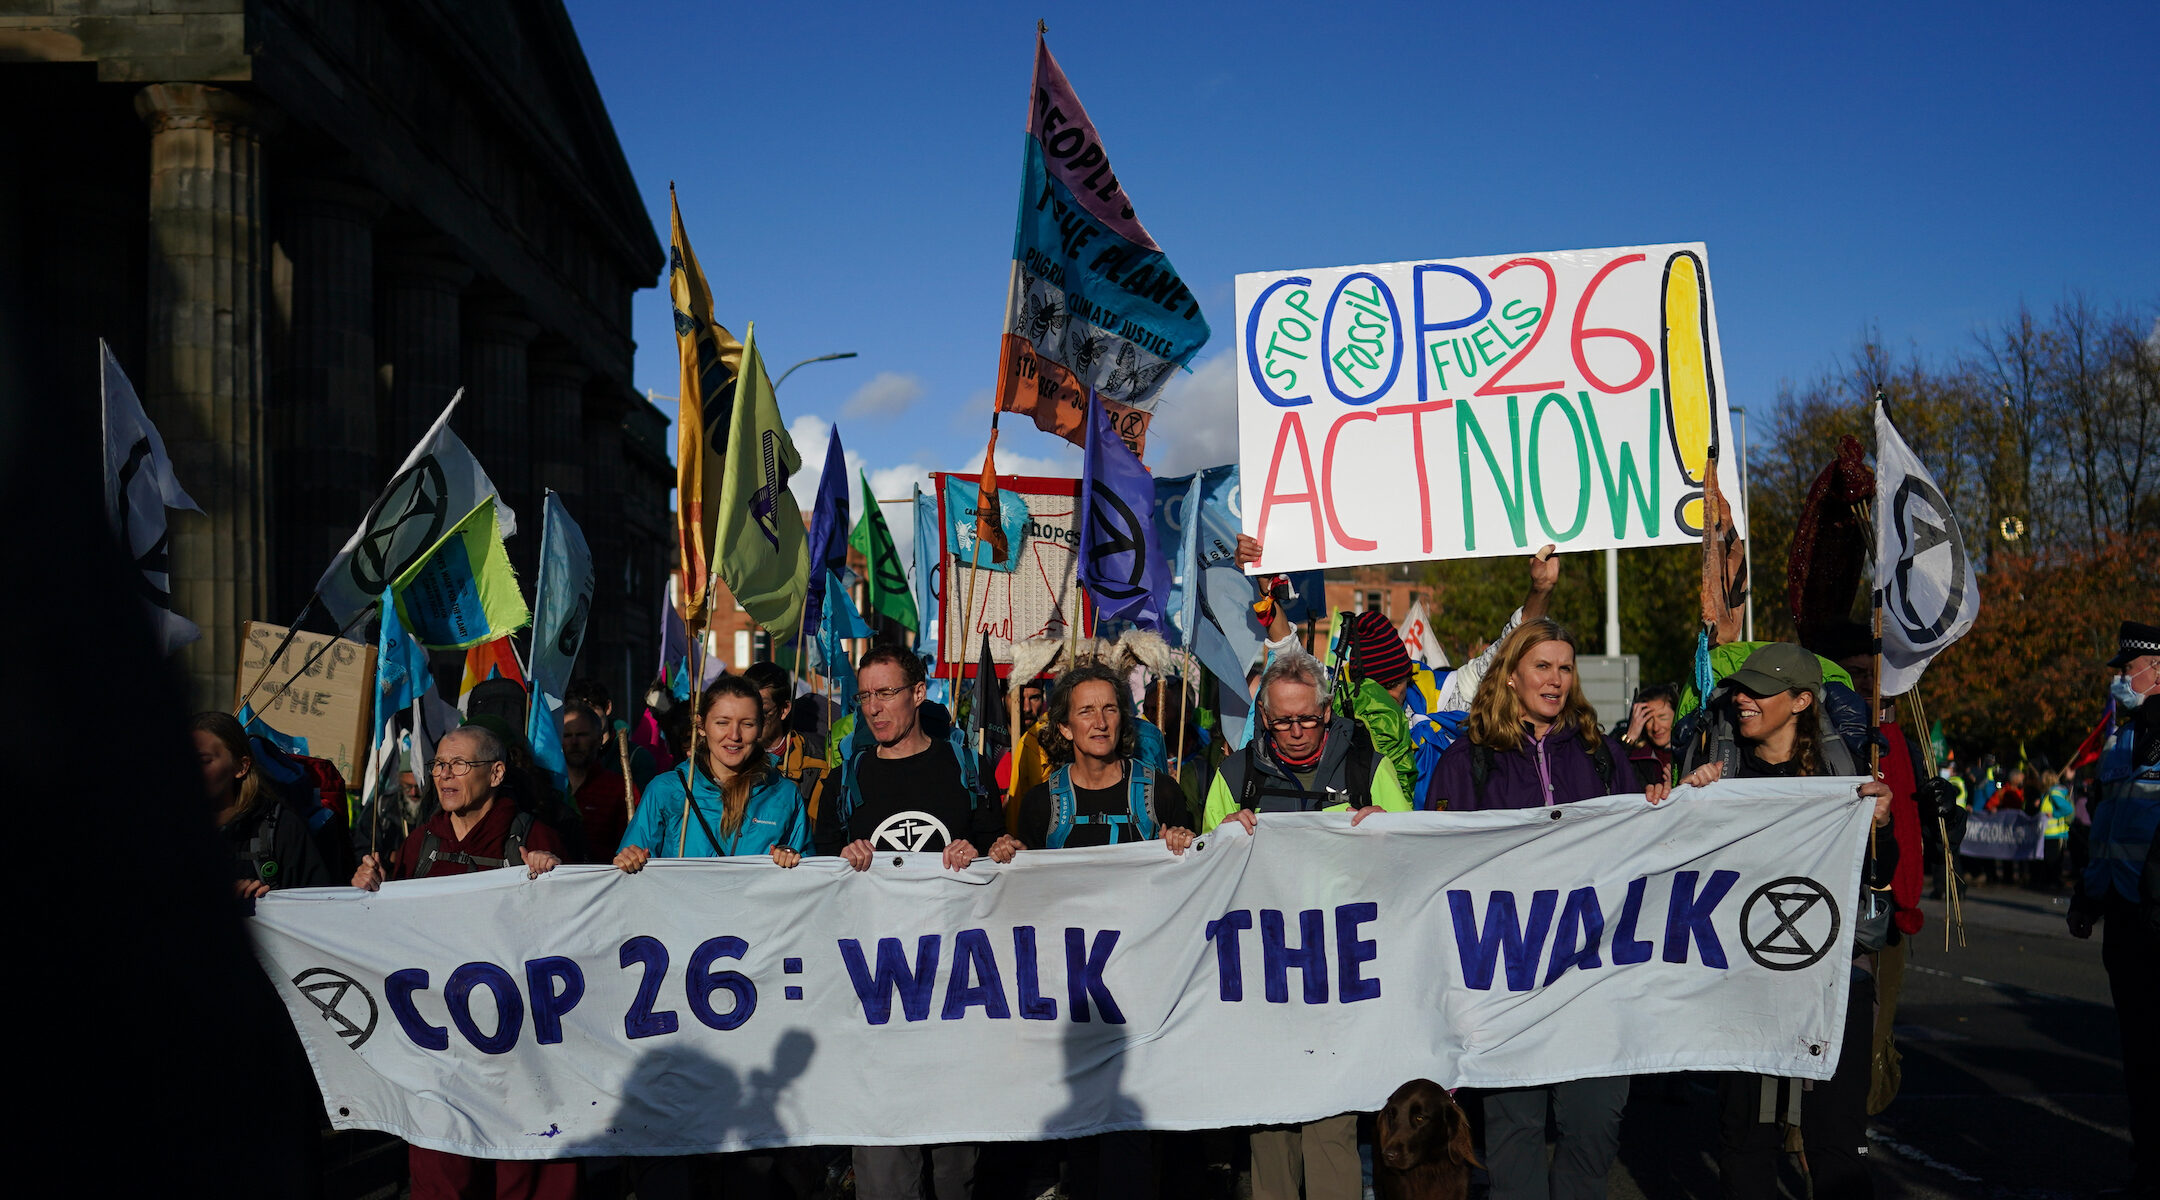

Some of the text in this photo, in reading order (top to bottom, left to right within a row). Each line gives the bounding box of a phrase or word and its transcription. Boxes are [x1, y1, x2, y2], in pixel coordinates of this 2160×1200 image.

[1068, 292, 1118, 330] CLIMATE
[1118, 319, 1174, 358] JUSTICE
[1265, 290, 1319, 391] STOP
[1430, 299, 1542, 391] FUELS
[1030, 517, 1081, 547] hopes
[244, 628, 357, 680] STOP
[261, 680, 333, 718] THE
[384, 955, 586, 1055] COP
[837, 925, 1127, 1025] WALK
[1206, 902, 1381, 1005] THE
[1447, 869, 1740, 992] WALK
